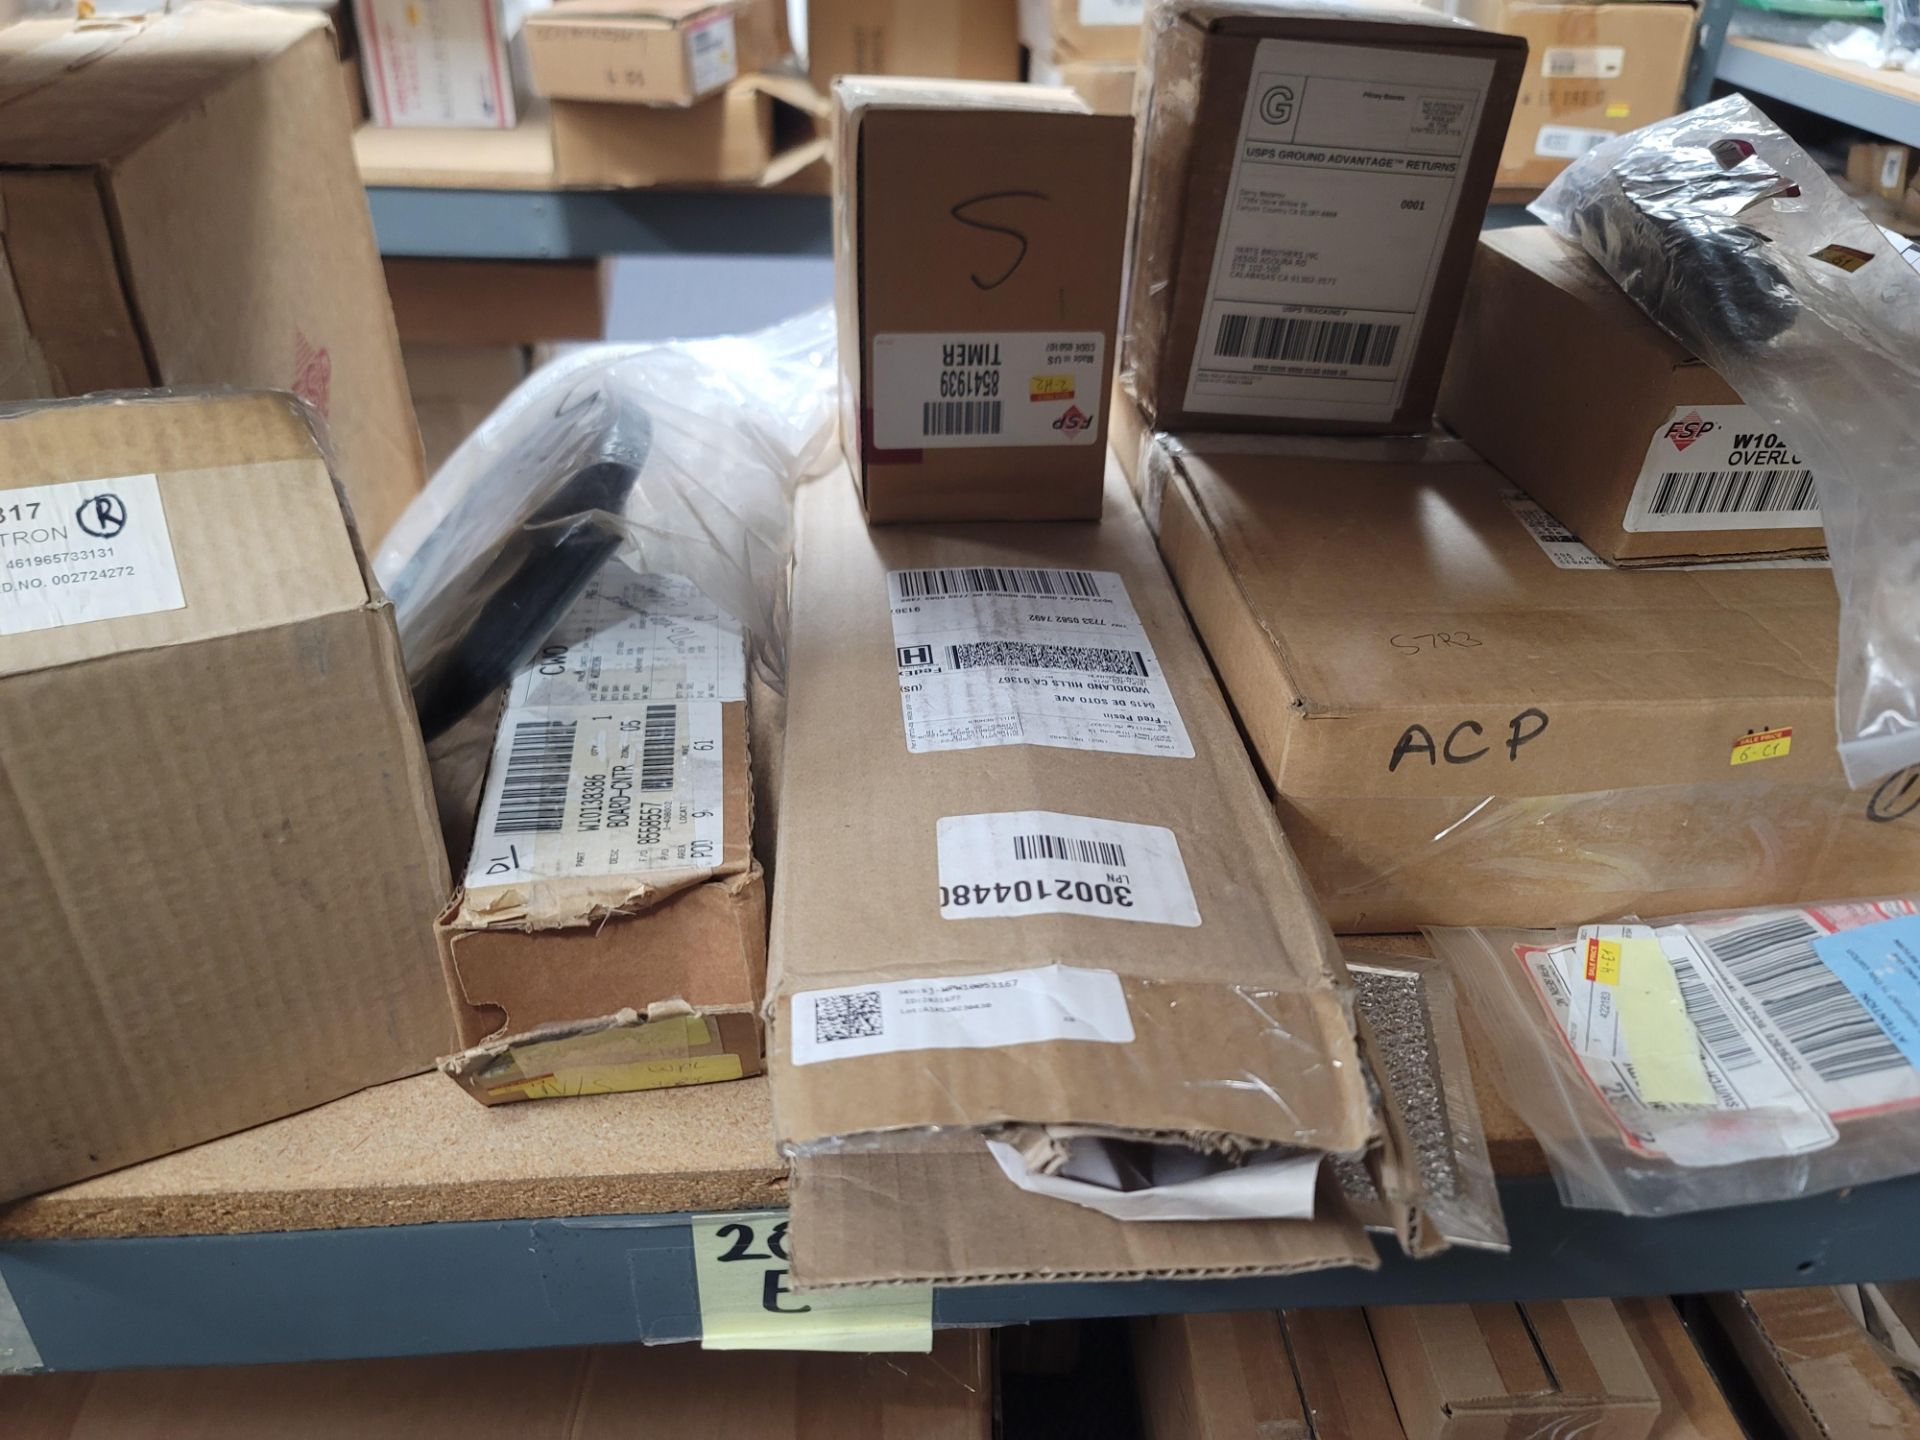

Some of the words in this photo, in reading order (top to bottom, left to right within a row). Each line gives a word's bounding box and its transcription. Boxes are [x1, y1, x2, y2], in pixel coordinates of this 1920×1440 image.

[1260, 85, 1294, 125] G
[1246, 148, 1277, 159] USPS
[1278, 150, 1326, 164] GROUND
[1405, 160, 1457, 173] RETURNS
[1400, 199, 1426, 212] 0001
[951, 190, 1050, 291] S
[943, 344, 1001, 366] TIMER
[941, 370, 999, 397] 8541939
[1052, 415, 1093, 429] FSP
[1664, 421, 1715, 438] FSP
[6, 548, 115, 569] 461965733131
[51, 566, 135, 585] 002724272
[1081, 615, 1107, 626] 7733
[998, 676, 1031, 685] 91367
[1033, 677, 1049, 687] CA
[1051, 679, 1084, 691] HILLS
[1088, 682, 1150, 695] WOODLAND
[1053, 694, 1076, 703] AVE
[1080, 696, 1110, 706] SOTO
[1113, 698, 1127, 706] DE
[1130, 699, 1156, 709] 6415
[1136, 714, 1161, 724] Fred
[620, 720, 641, 732] 05
[693, 739, 714, 752] 61
[1388, 707, 1549, 773] ACP
[578, 773, 606, 832] W10138386
[606, 764, 635, 829] BOARD-CNTR
[637, 802, 663, 845] 8558557
[1106, 873, 1130, 885] LPN
[763, 1269, 812, 1313] E
